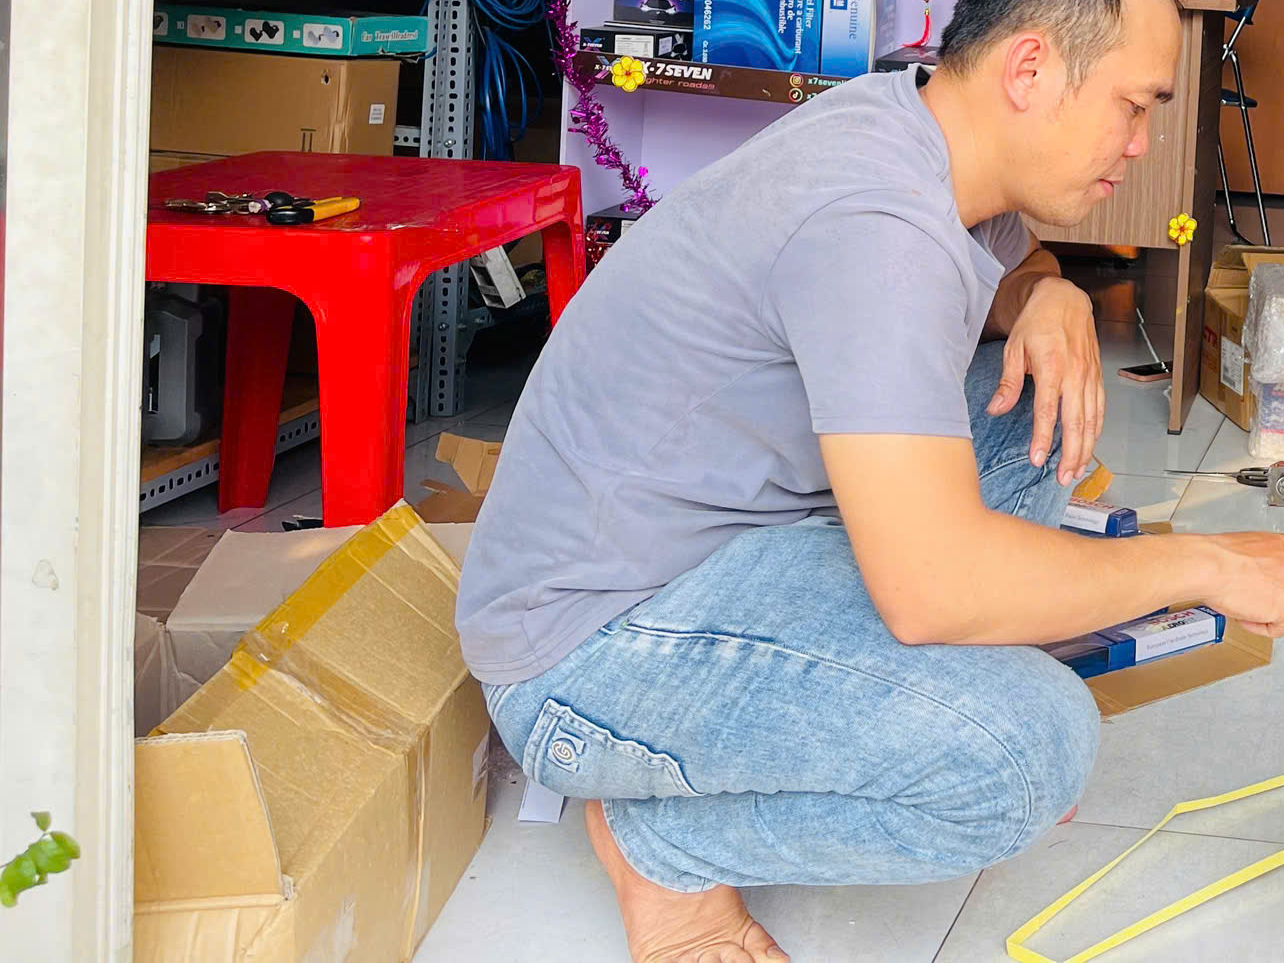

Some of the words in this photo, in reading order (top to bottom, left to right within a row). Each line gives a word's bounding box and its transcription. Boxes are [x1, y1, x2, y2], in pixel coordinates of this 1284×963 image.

[787, 11, 794, 21] de
[805, 7, 814, 29] Filter
[795, 17, 803, 54] carburant
[645, 77, 674, 86] ghter
[1070, 497, 1115, 510] BOSCH
[1151, 611, 1196, 625] BOSCH
